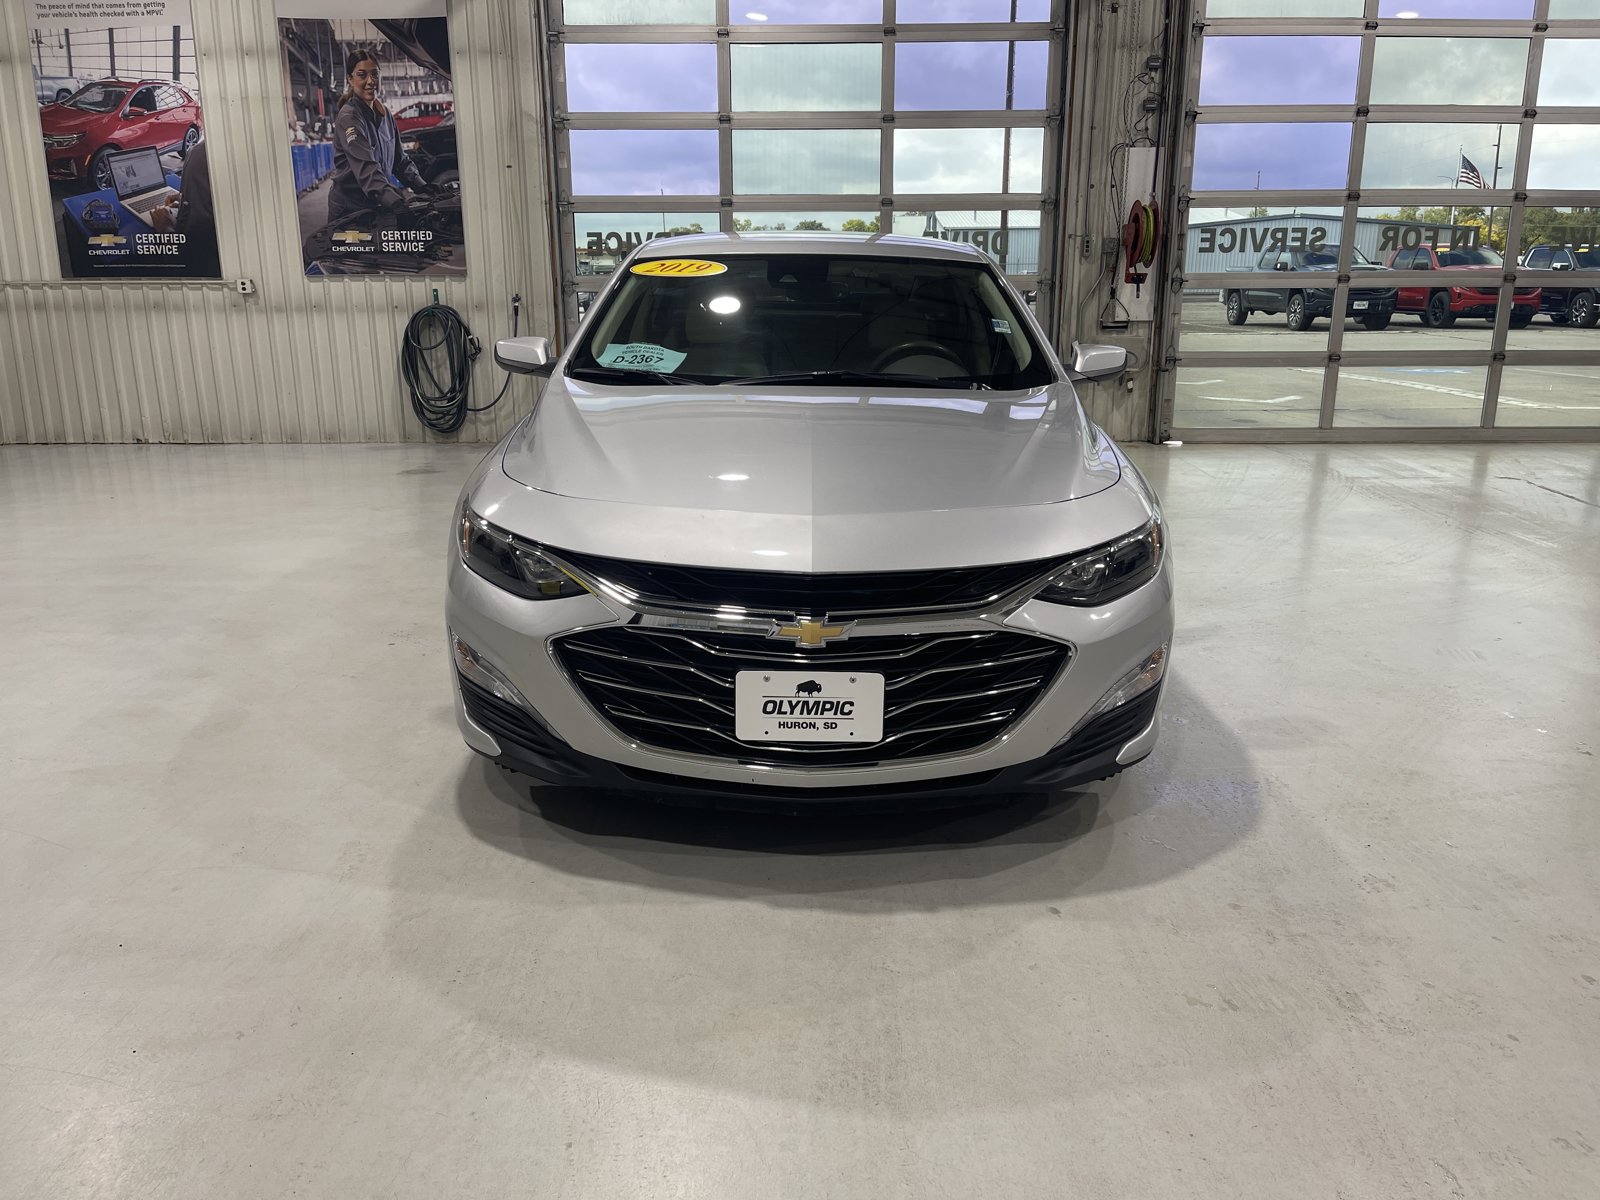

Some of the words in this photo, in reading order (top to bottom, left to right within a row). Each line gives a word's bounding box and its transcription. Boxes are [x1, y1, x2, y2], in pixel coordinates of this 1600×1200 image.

[75, 2, 90, 10] mind
[91, 2, 104, 10] that
[126, 1, 142, 9] from
[143, 1, 166, 10] getting
[36, 12, 50, 20] your
[78, 10, 99, 18] health
[99, 10, 125, 18] checked
[126, 9, 140, 17] with
[135, 233, 187, 244] CERTIFIED
[380, 230, 433, 241] CERTIFIED
[136, 245, 179, 255] SERVICE
[382, 242, 425, 252] SERVICE
[643, 263, 713, 273] 2019
[613, 355, 664, 364] D-2367
[762, 700, 855, 716] OLYMPIC
[778, 721, 820, 731] HURON,
[823, 722, 838, 730] SD
